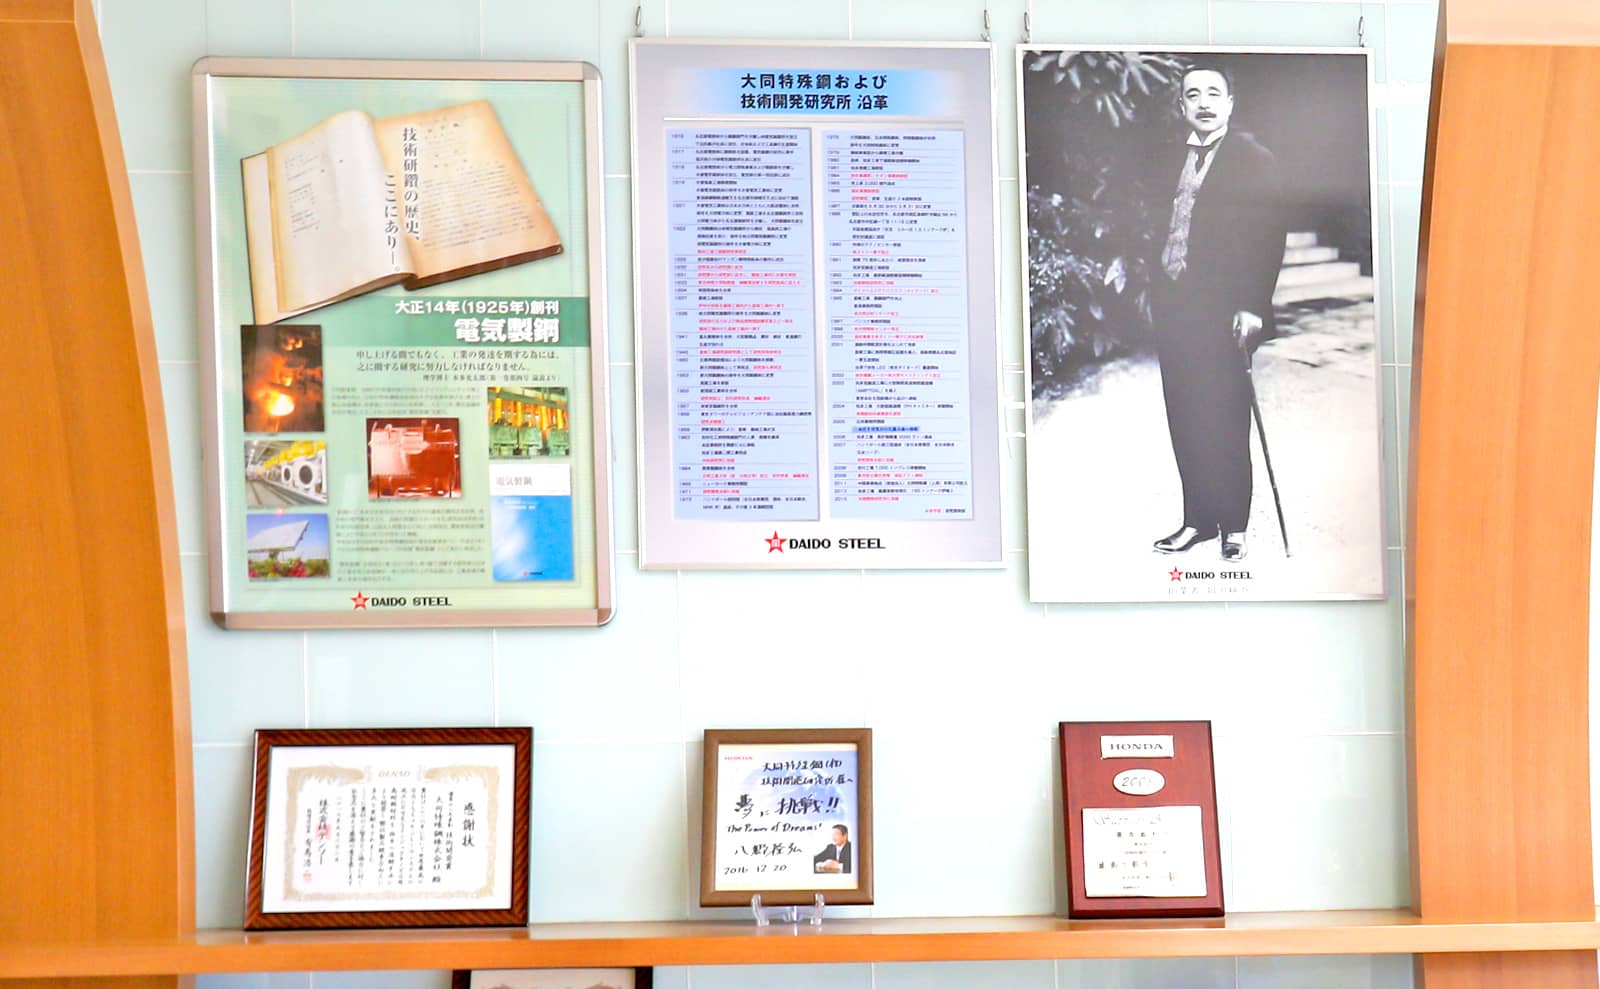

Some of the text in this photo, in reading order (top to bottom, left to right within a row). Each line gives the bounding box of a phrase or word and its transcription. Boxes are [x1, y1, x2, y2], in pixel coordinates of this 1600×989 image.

[740, 73, 888, 90] 大同特殊鋼および
[740, 93, 889, 110] 技術開発研究所 沿革
[395, 300, 560, 315] 大正14年(1925年)創刊
[454, 318, 560, 343] 電気製鋼
[789, 537, 886, 550] DAIDO STEEL
[1184, 571, 1253, 580] DAIDO STEEL
[370, 597, 453, 607] DAIDO STEEL
[1109, 743, 1164, 751] HONDA
